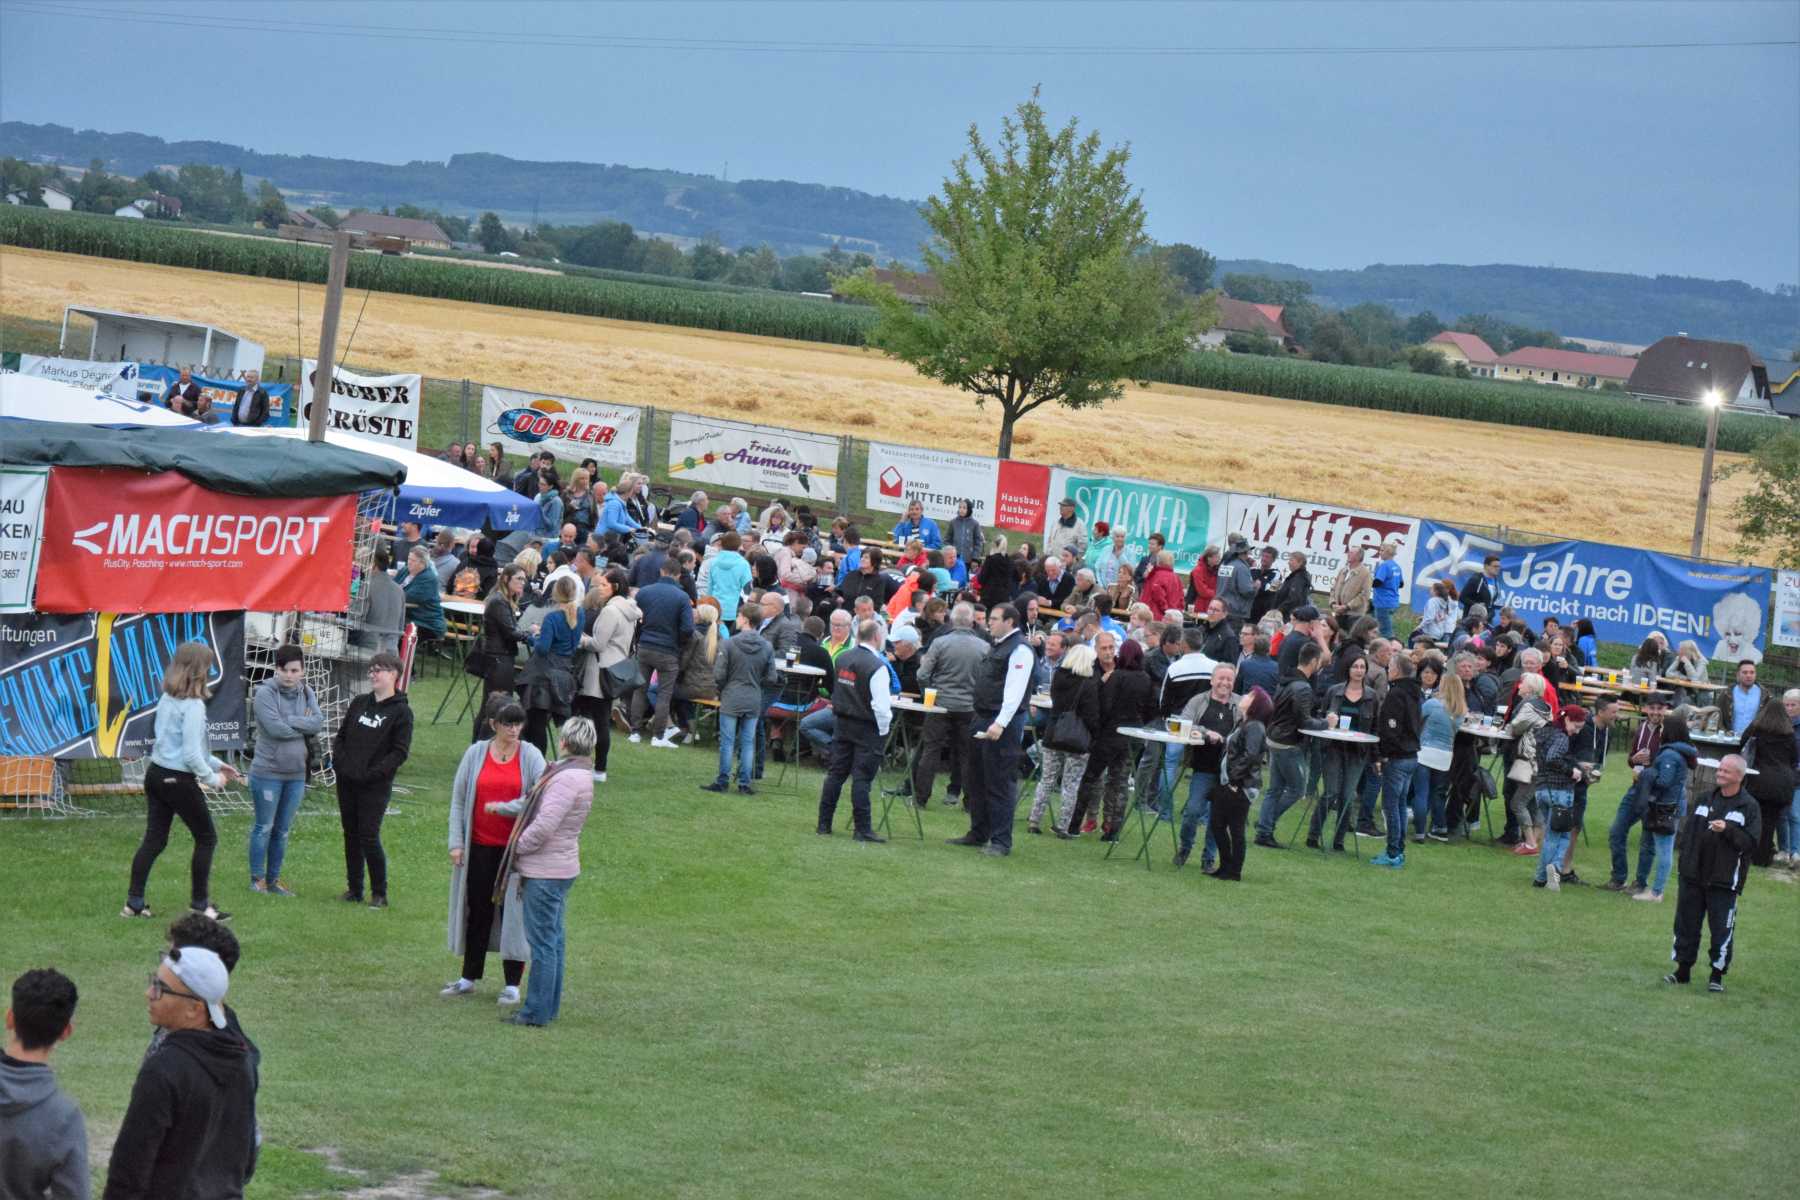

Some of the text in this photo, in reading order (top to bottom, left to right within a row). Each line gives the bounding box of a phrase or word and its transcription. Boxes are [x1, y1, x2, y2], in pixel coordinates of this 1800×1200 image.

[41, 364, 78, 377] Markus
[750, 440, 791, 456] Früchte
[724, 448, 813, 475] Aumayr
[905, 480, 930, 490] JAKOB
[0, 500, 25, 514] AU
[409, 503, 442, 519] Zipfer
[1075, 487, 1188, 544] STOCKER
[107, 513, 331, 556] MACHSPORT
[1415, 530, 1633, 600] 25 Jahre
[1499, 590, 1711, 637] Verrückt nach IDEEN!
